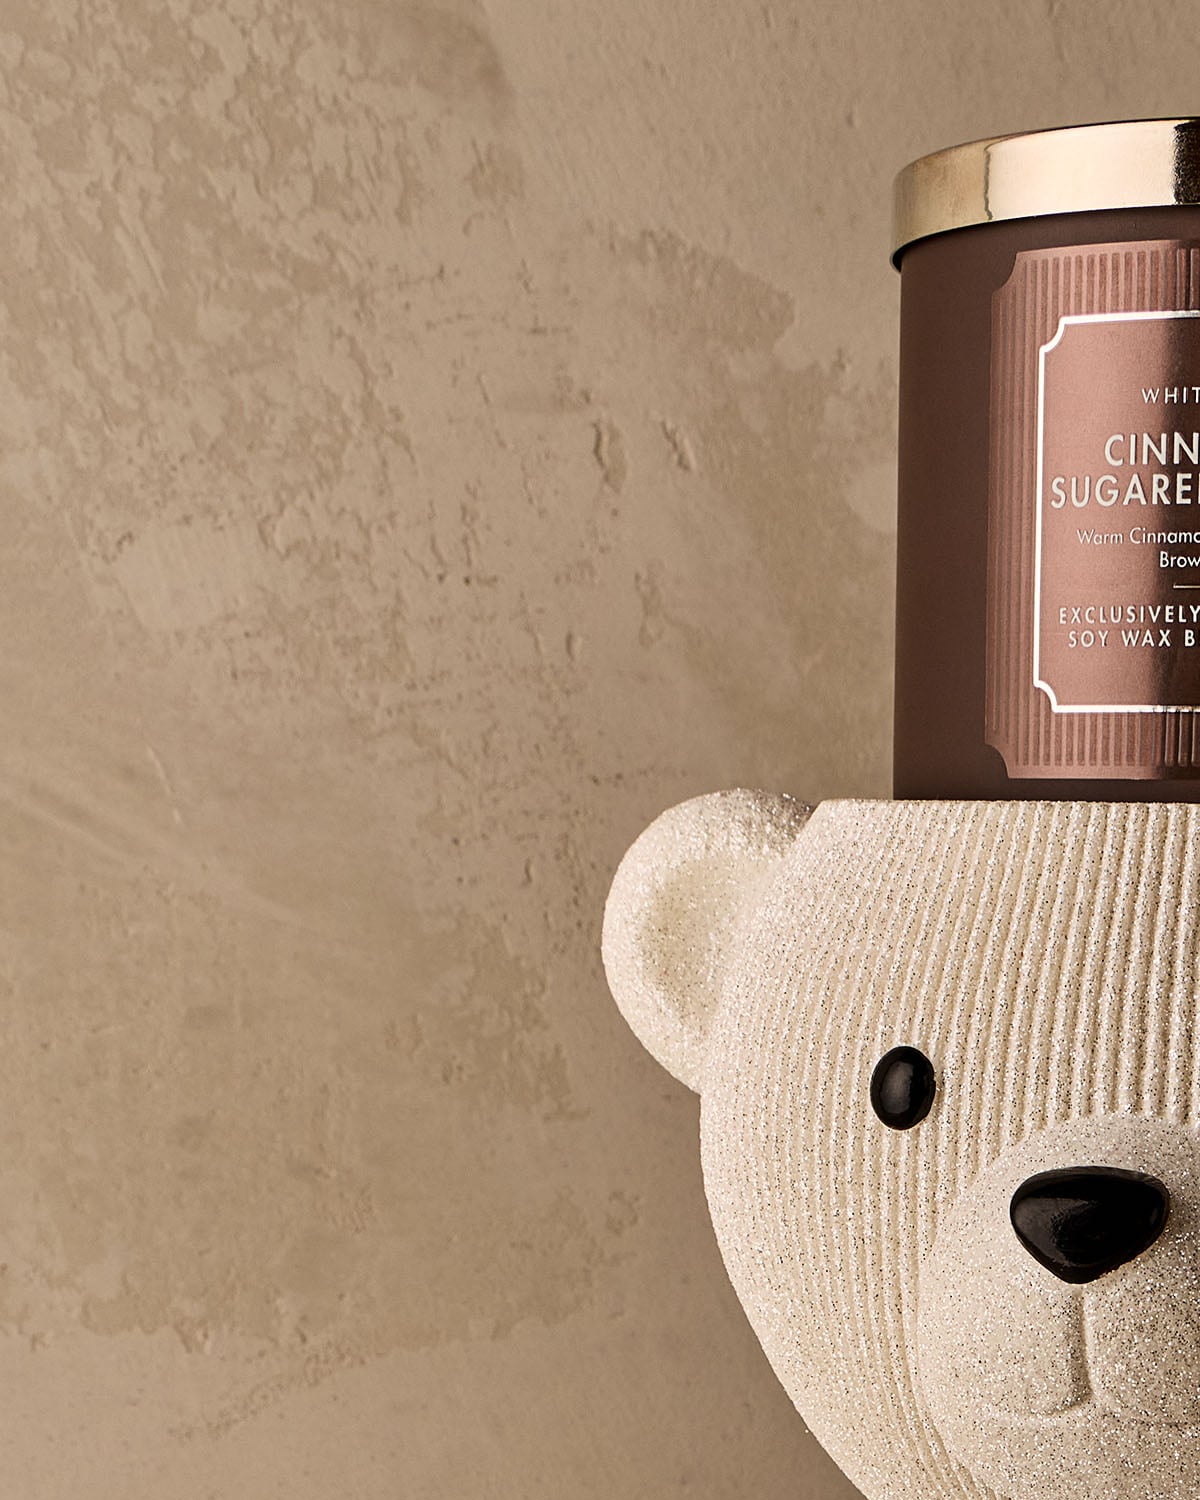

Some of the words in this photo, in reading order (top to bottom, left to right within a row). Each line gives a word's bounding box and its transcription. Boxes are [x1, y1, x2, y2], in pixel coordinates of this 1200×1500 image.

[1077, 529, 1123, 545] Warm
[1059, 605, 1200, 625] EXCLUSIVELY
[1069, 631, 1109, 648] SOY
[1122, 630, 1171, 648] WAX
